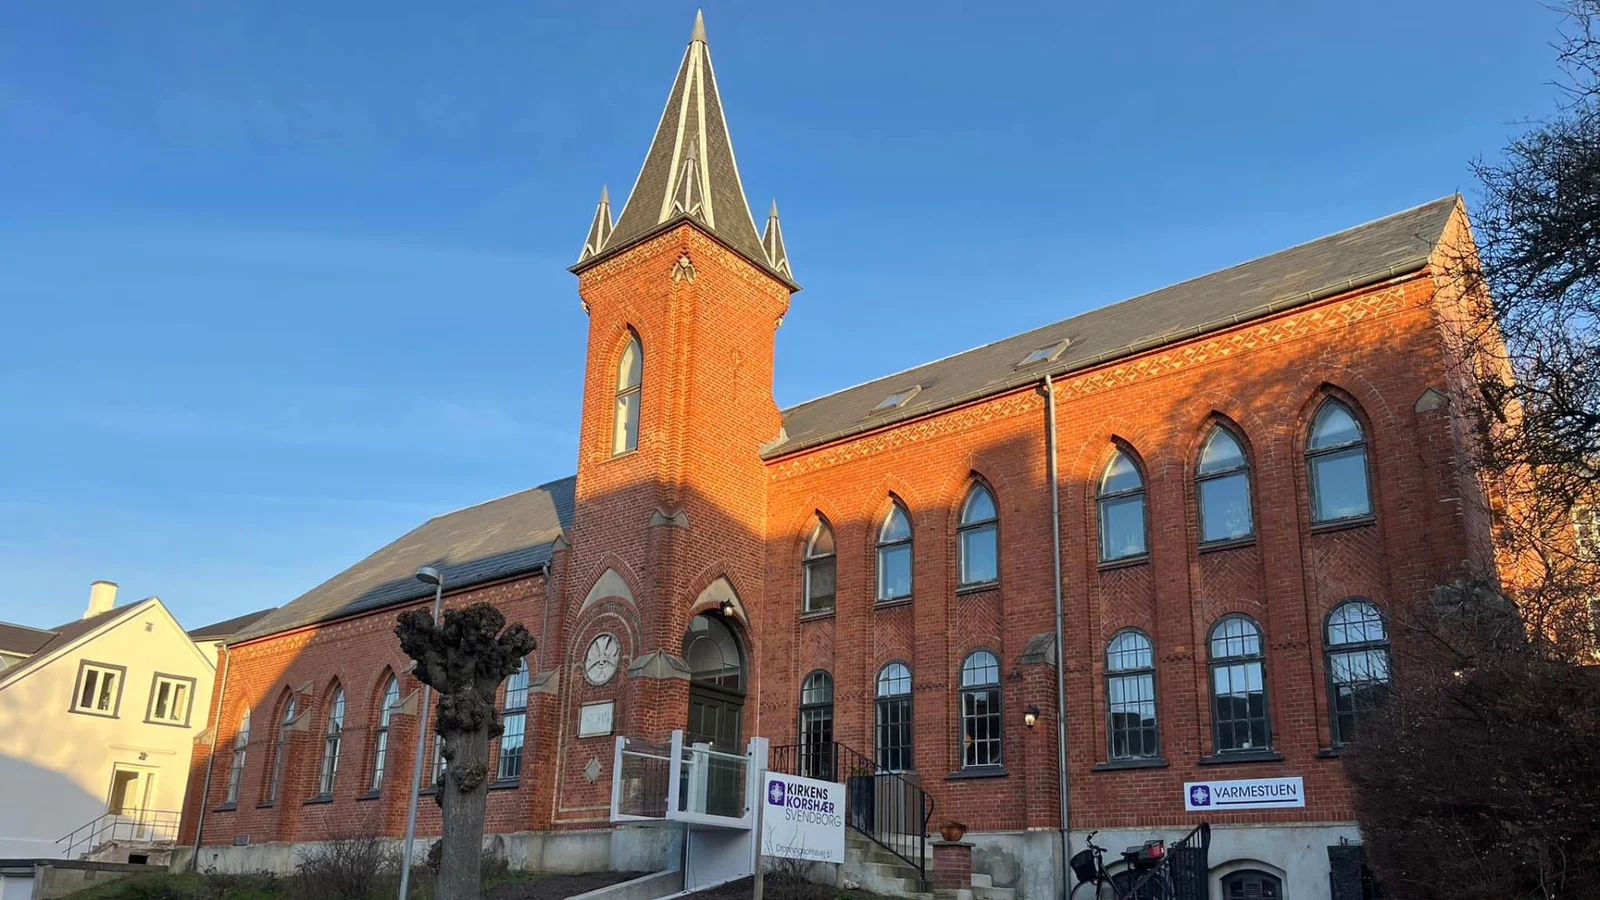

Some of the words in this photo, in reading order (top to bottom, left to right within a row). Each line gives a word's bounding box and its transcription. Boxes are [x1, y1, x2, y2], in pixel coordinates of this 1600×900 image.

[787, 783, 828, 800] KIRKENS
[1214, 784, 1296, 798] VARMESTUEN
[786, 796, 834, 814] KORSHÆR
[785, 808, 842, 827] SVENDBORG
